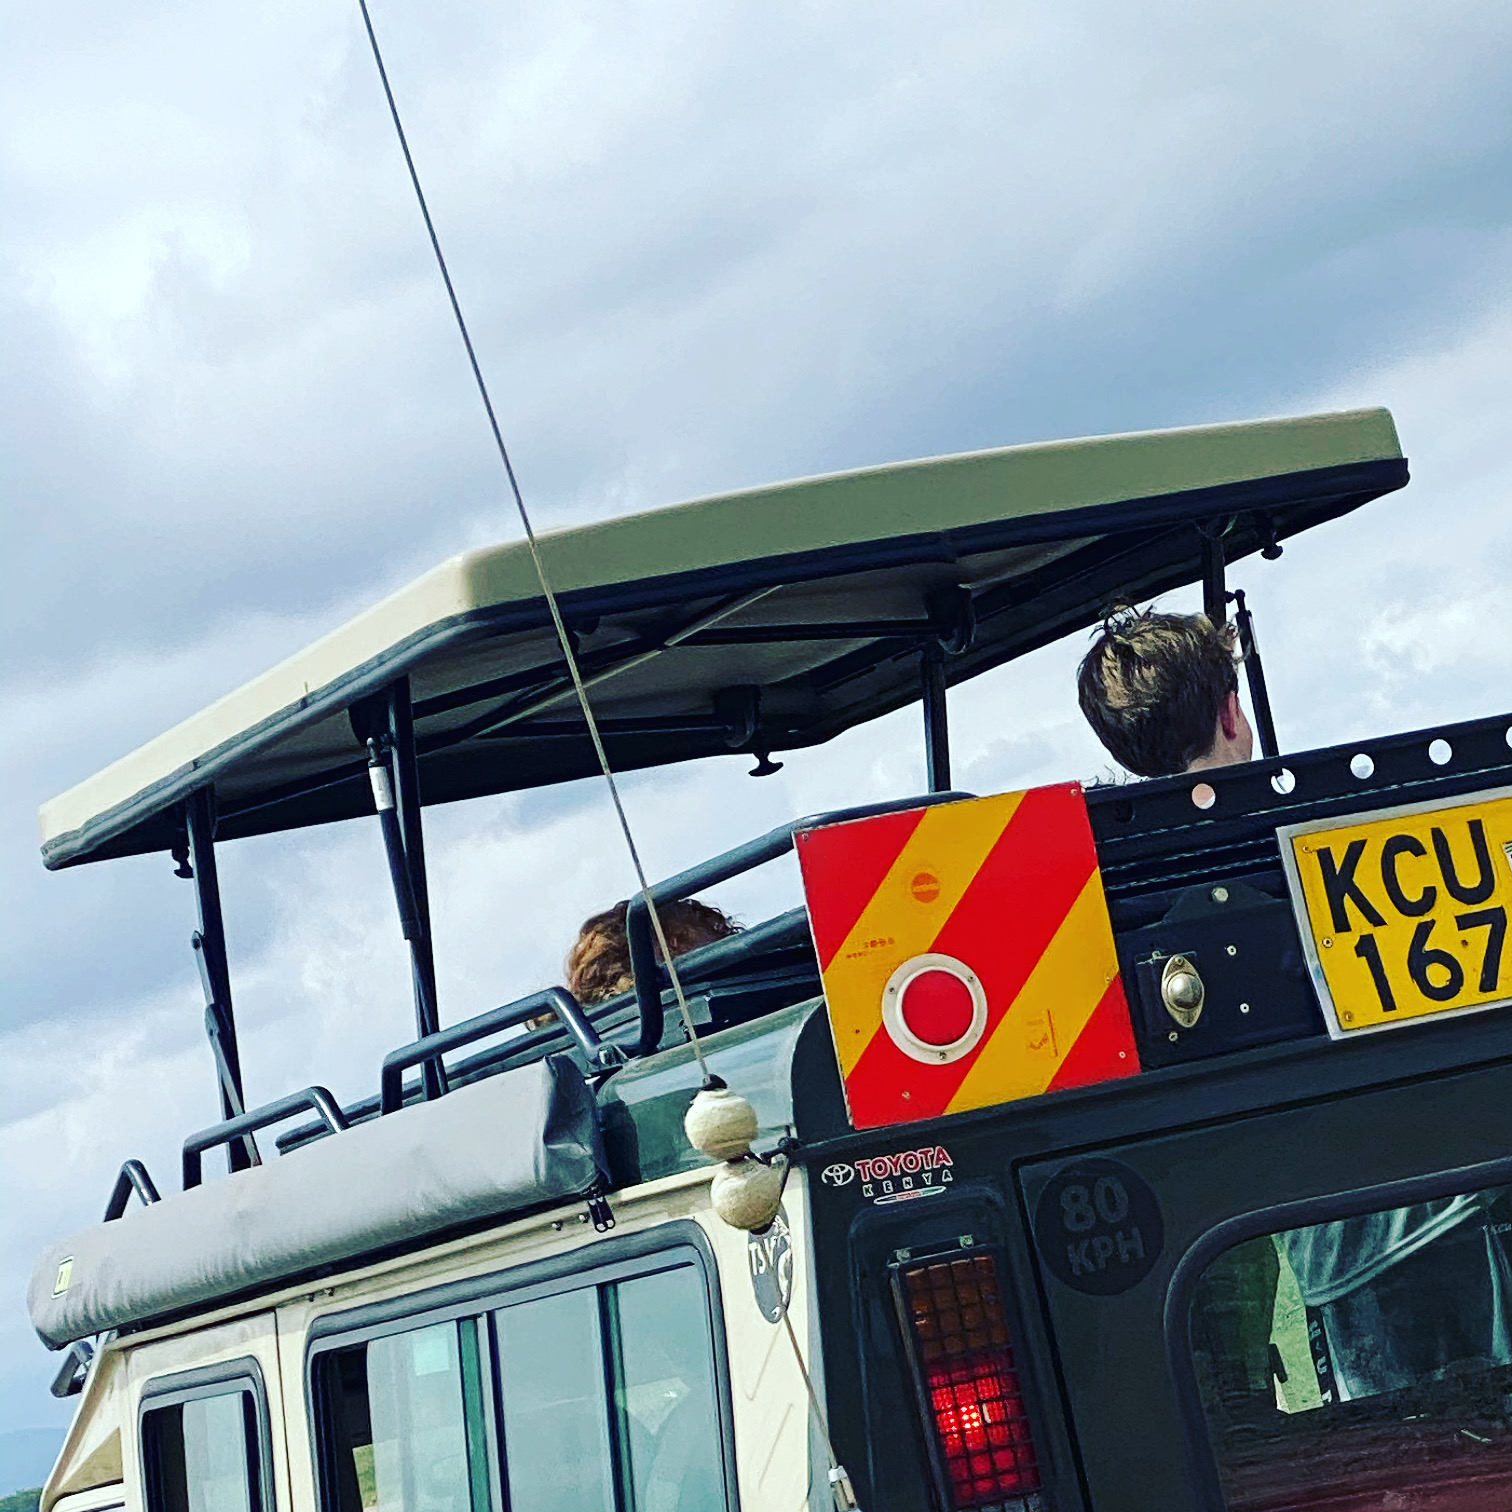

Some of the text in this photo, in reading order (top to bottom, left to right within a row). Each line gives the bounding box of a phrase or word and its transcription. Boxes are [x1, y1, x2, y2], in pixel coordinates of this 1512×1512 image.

[1316, 819, 1495, 933] KCU
[855, 1146, 953, 1182] TOYOTA
[862, 1170, 953, 1197] KENYA
[1060, 1176, 1128, 1232] 80
[1067, 1227, 1145, 1276] KPH
